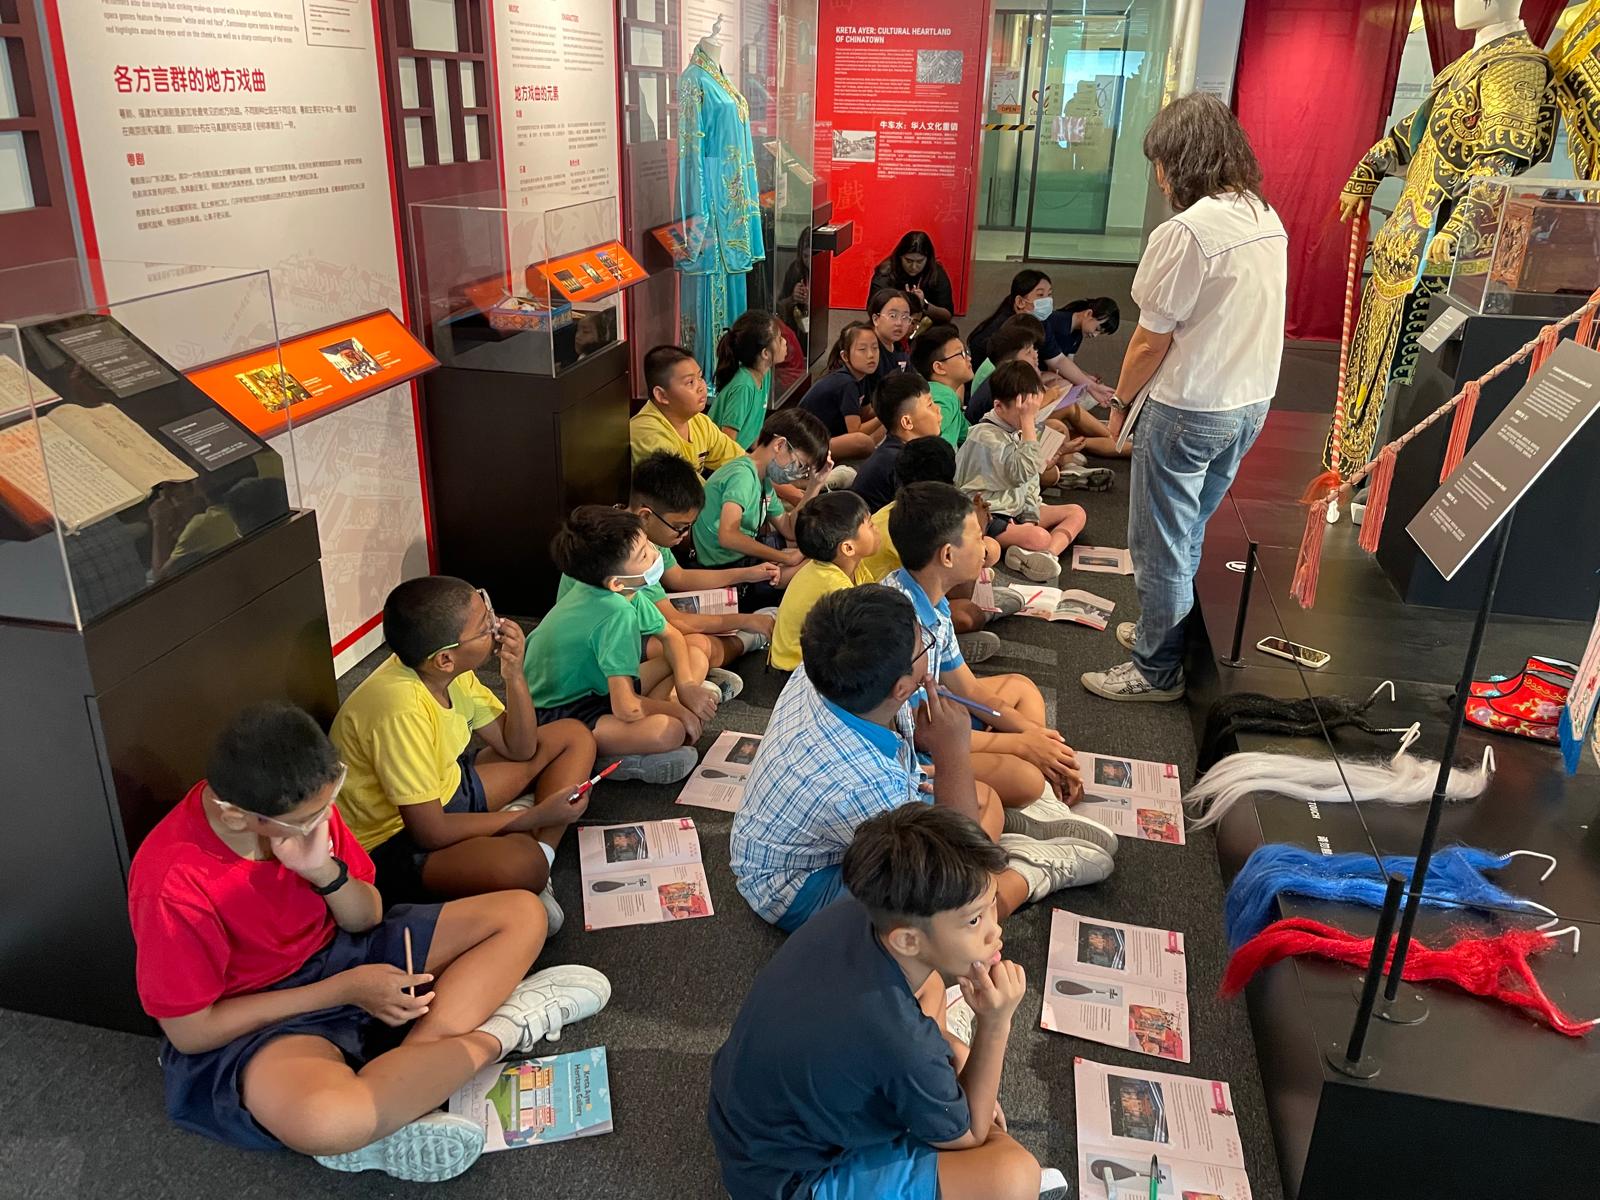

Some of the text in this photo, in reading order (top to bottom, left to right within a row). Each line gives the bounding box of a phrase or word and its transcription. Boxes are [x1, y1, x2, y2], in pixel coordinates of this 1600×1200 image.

[836, 26, 952, 36] KRETA AYER: CULTURAL HEARTLAND
[845, 36, 885, 44] CHINATOWN
[114, 65, 267, 93] 各方言群的地方戏曲
[575, 1093, 583, 1116] Gallery
